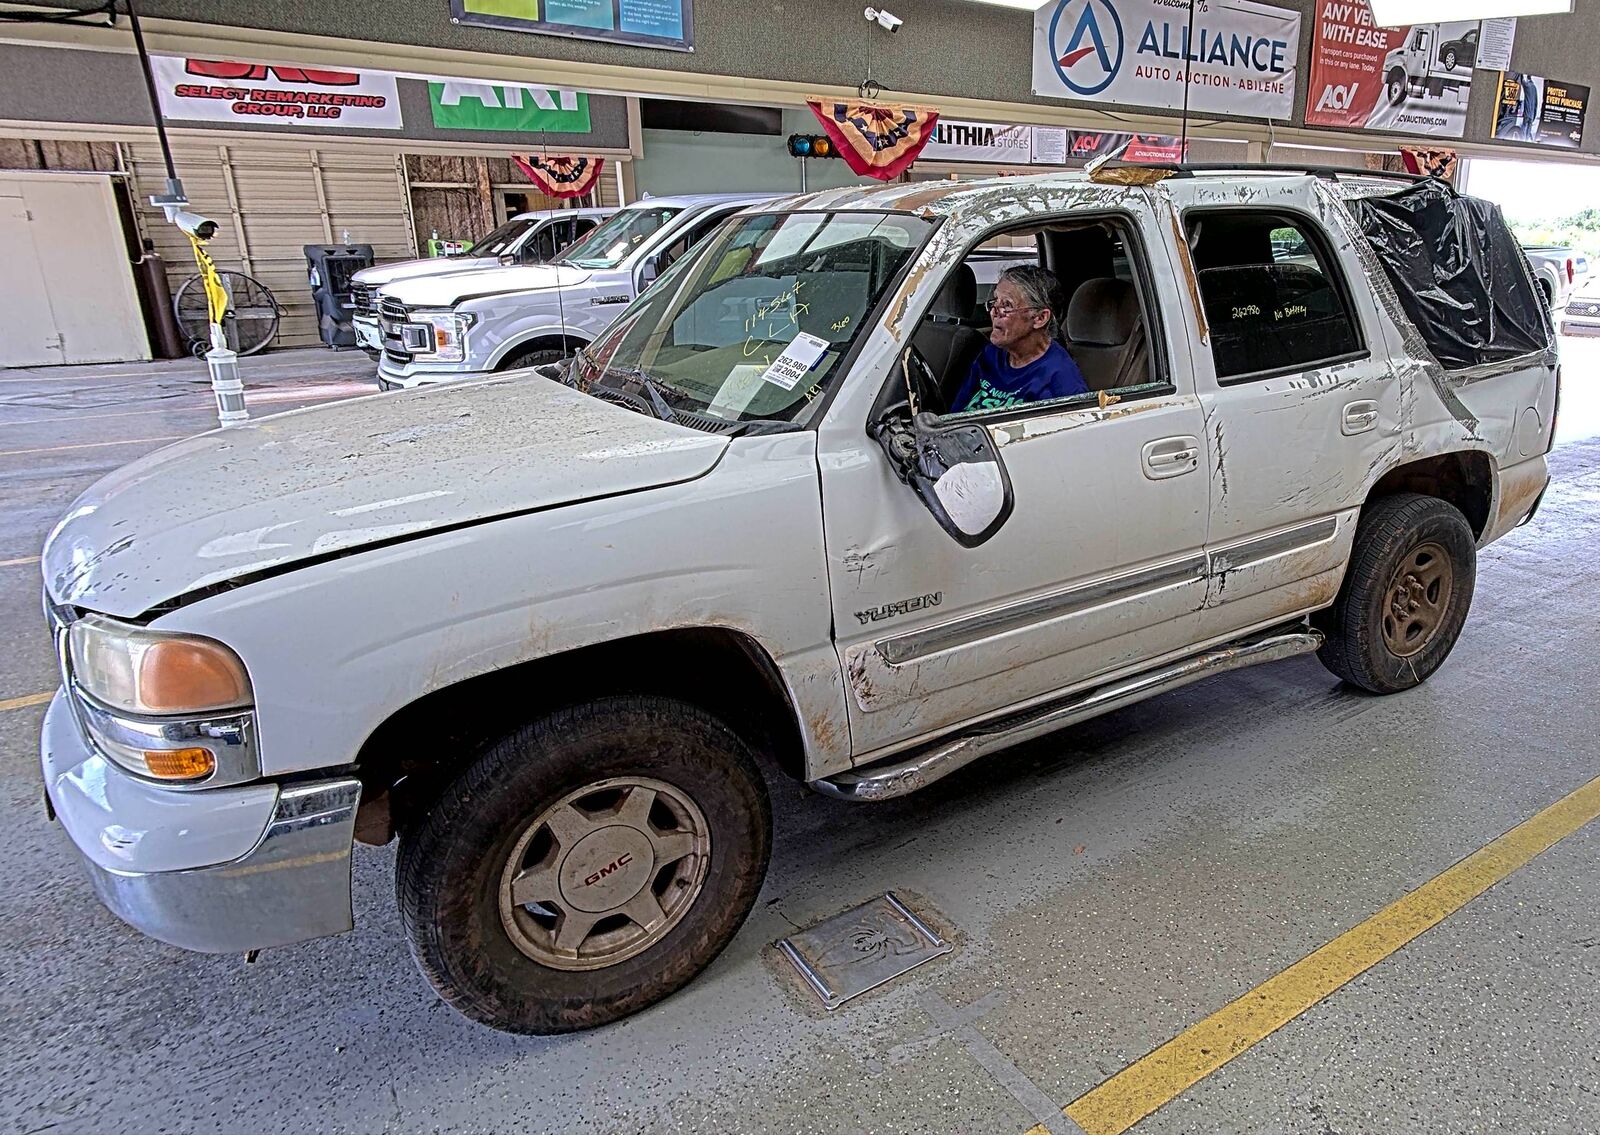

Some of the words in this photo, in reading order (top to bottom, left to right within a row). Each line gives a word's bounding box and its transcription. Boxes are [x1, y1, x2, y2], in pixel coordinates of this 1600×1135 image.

[1322, 2, 1352, 23] ANY
[1322, 22, 1355, 44] WITH
[1356, 28, 1388, 49] EASE.
[1137, 20, 1287, 73] ALLIANCE
[1321, 45, 1342, 56] Transport
[1353, 53, 1378, 62] purchased
[1324, 57, 1333, 66] this
[1340, 61, 1349, 69] any
[1349, 61, 1360, 70] lane.
[1135, 65, 1170, 80] AUTO
[175, 84, 249, 99] SELECT
[251, 88, 386, 108] REMARKETING
[1315, 83, 1359, 112] ACV
[1546, 95, 1561, 105] EVERY
[1547, 86, 1567, 97] PROTECT
[232, 102, 303, 118] GROUP,
[306, 105, 342, 118] LLC
[1397, 114, 1448, 127] CVAUCTIONS.COM
[937, 123, 996, 147] LITHIA
[997, 128, 1020, 139] AUTO
[1072, 133, 1102, 152] ACV
[996, 139, 1029, 150] STORES
[1231, 304, 1260, 319] 262980
[777, 355, 808, 373] 262,980
[780, 367, 801, 380] 2004
[854, 591, 943, 625] YUKON
[584, 852, 633, 886] GMC
